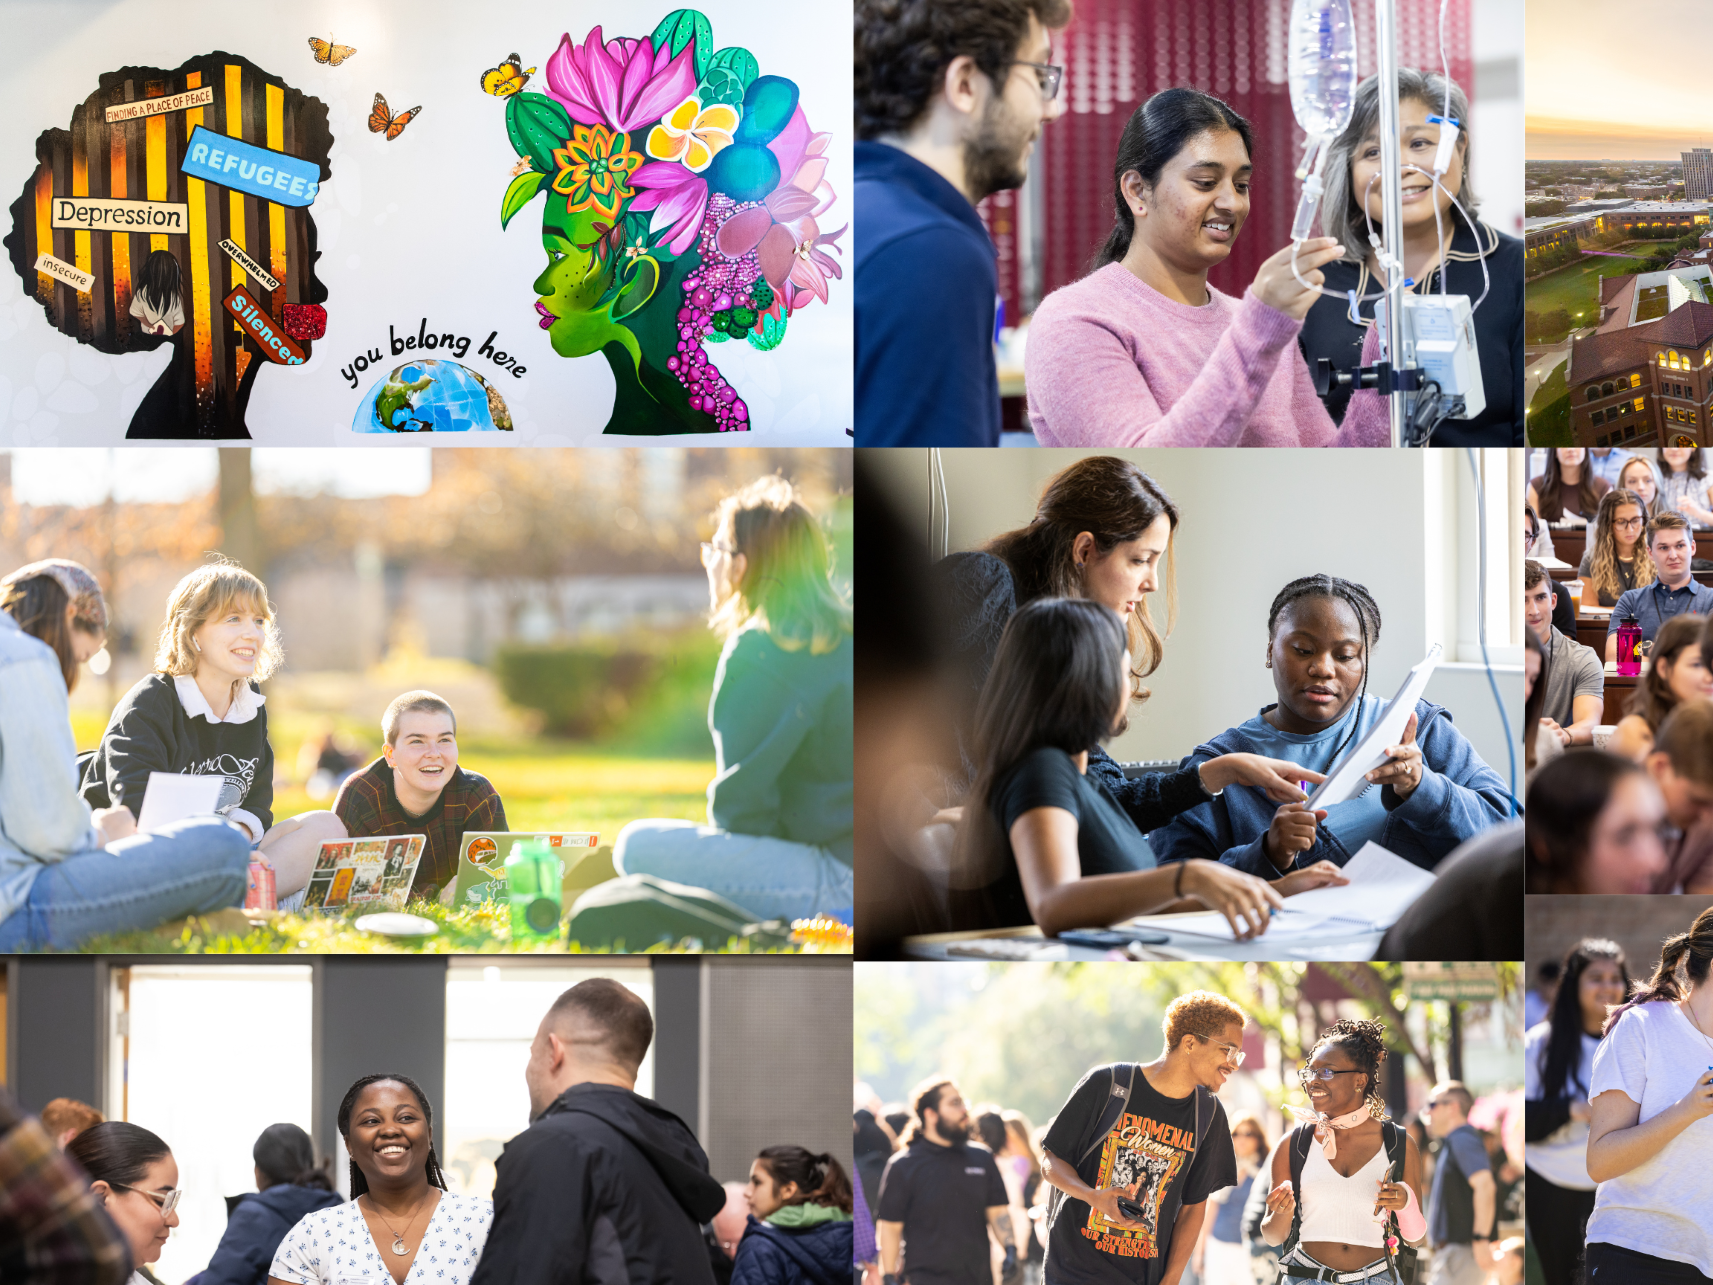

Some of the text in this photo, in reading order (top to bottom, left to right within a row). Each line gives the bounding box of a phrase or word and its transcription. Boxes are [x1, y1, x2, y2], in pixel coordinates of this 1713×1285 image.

[106, 90, 211, 122] FINDING A PLACE OF PEACE
[191, 143, 318, 200] REFUGEES
[58, 201, 180, 227] Depression
[43, 258, 87, 285] insecure
[222, 241, 277, 288] OVERWHELMED
[231, 295, 303, 365] Silenced
[341, 318, 527, 389] you belong here
[1120, 1126, 1177, 1158] Women
[1081, 1228, 1098, 1240] OUR
[1095, 1241, 1116, 1254] OUR
